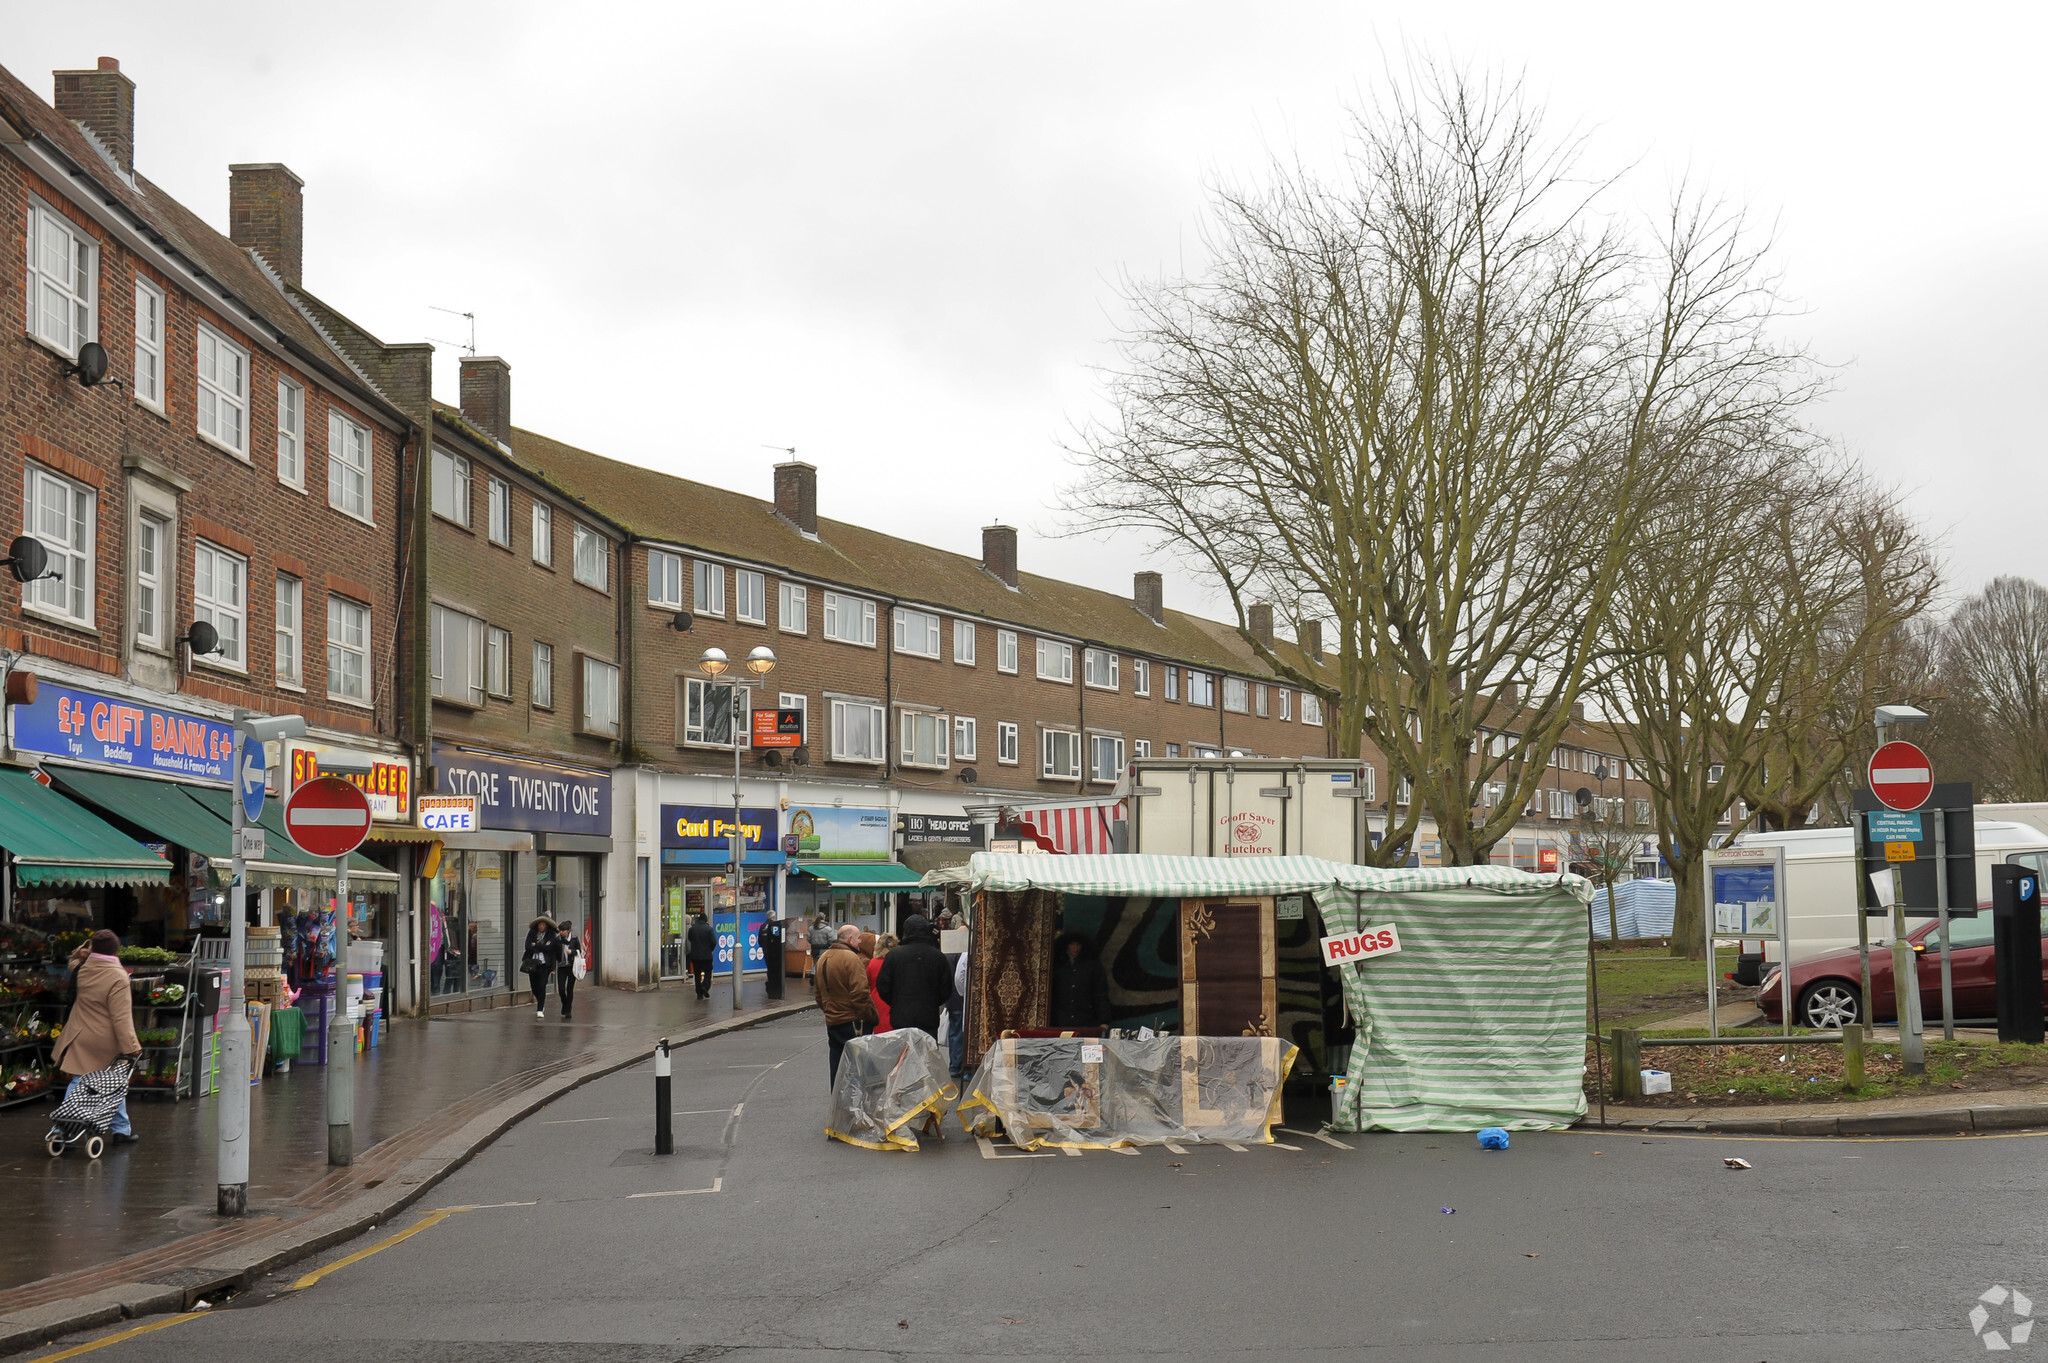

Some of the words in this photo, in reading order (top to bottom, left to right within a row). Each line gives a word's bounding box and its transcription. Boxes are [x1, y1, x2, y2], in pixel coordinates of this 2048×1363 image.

[58, 697, 85, 736] £+
[91, 702, 145, 747] GIFT
[151, 713, 207, 759] BANK
[210, 730, 232, 761] £+
[68, 738, 83, 756] Toys
[104, 745, 133, 763] Bedding
[153, 754, 184, 770] Household
[183, 761, 189, 770] &
[189, 761, 206, 776] Fancy
[295, 753, 408, 793] STURGER
[448, 767, 499, 806] STORE
[508, 775, 570, 813] TWENTY
[572, 785, 599, 816] ONE
[424, 814, 470, 829] CAFE
[677, 818, 709, 837] Card
[911, 818, 923, 830] 110
[1220, 812, 1247, 825] Geoff
[1249, 812, 1276, 825] Sayer
[243, 835, 253, 850] One
[254, 840, 263, 853] way
[1224, 844, 1272, 854] Butchers
[1717, 850, 1741, 858] CROYDON
[1741, 849, 1765, 857] COUNCIL
[2021, 879, 2031, 897] P
[1328, 930, 1394, 959] RUGS
